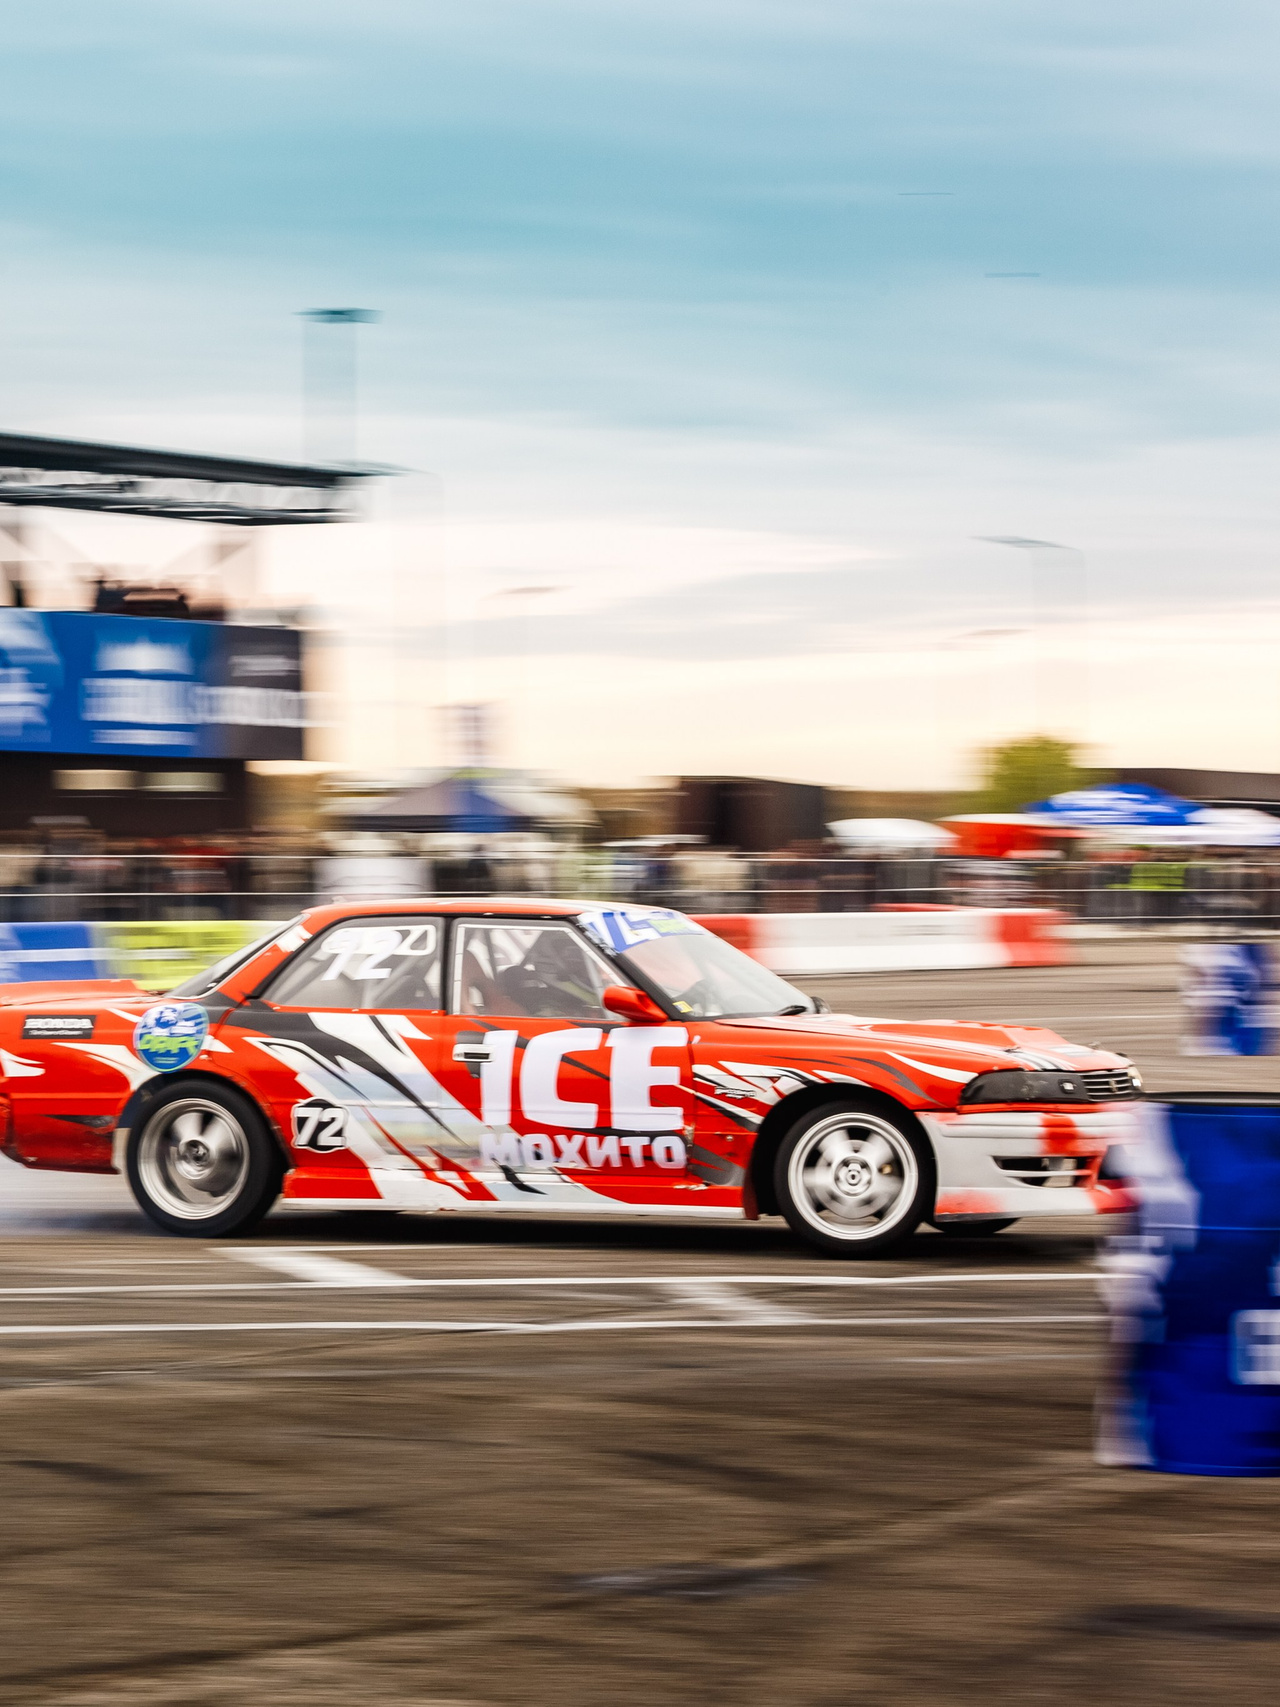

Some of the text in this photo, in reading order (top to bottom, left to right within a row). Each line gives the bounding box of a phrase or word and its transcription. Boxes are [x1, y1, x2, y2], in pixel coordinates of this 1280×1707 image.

[321, 929, 403, 980] 72
[480, 1026, 688, 1131] ICE
[294, 1107, 349, 1146] 72
[479, 1133, 687, 1169] МОХИТО
